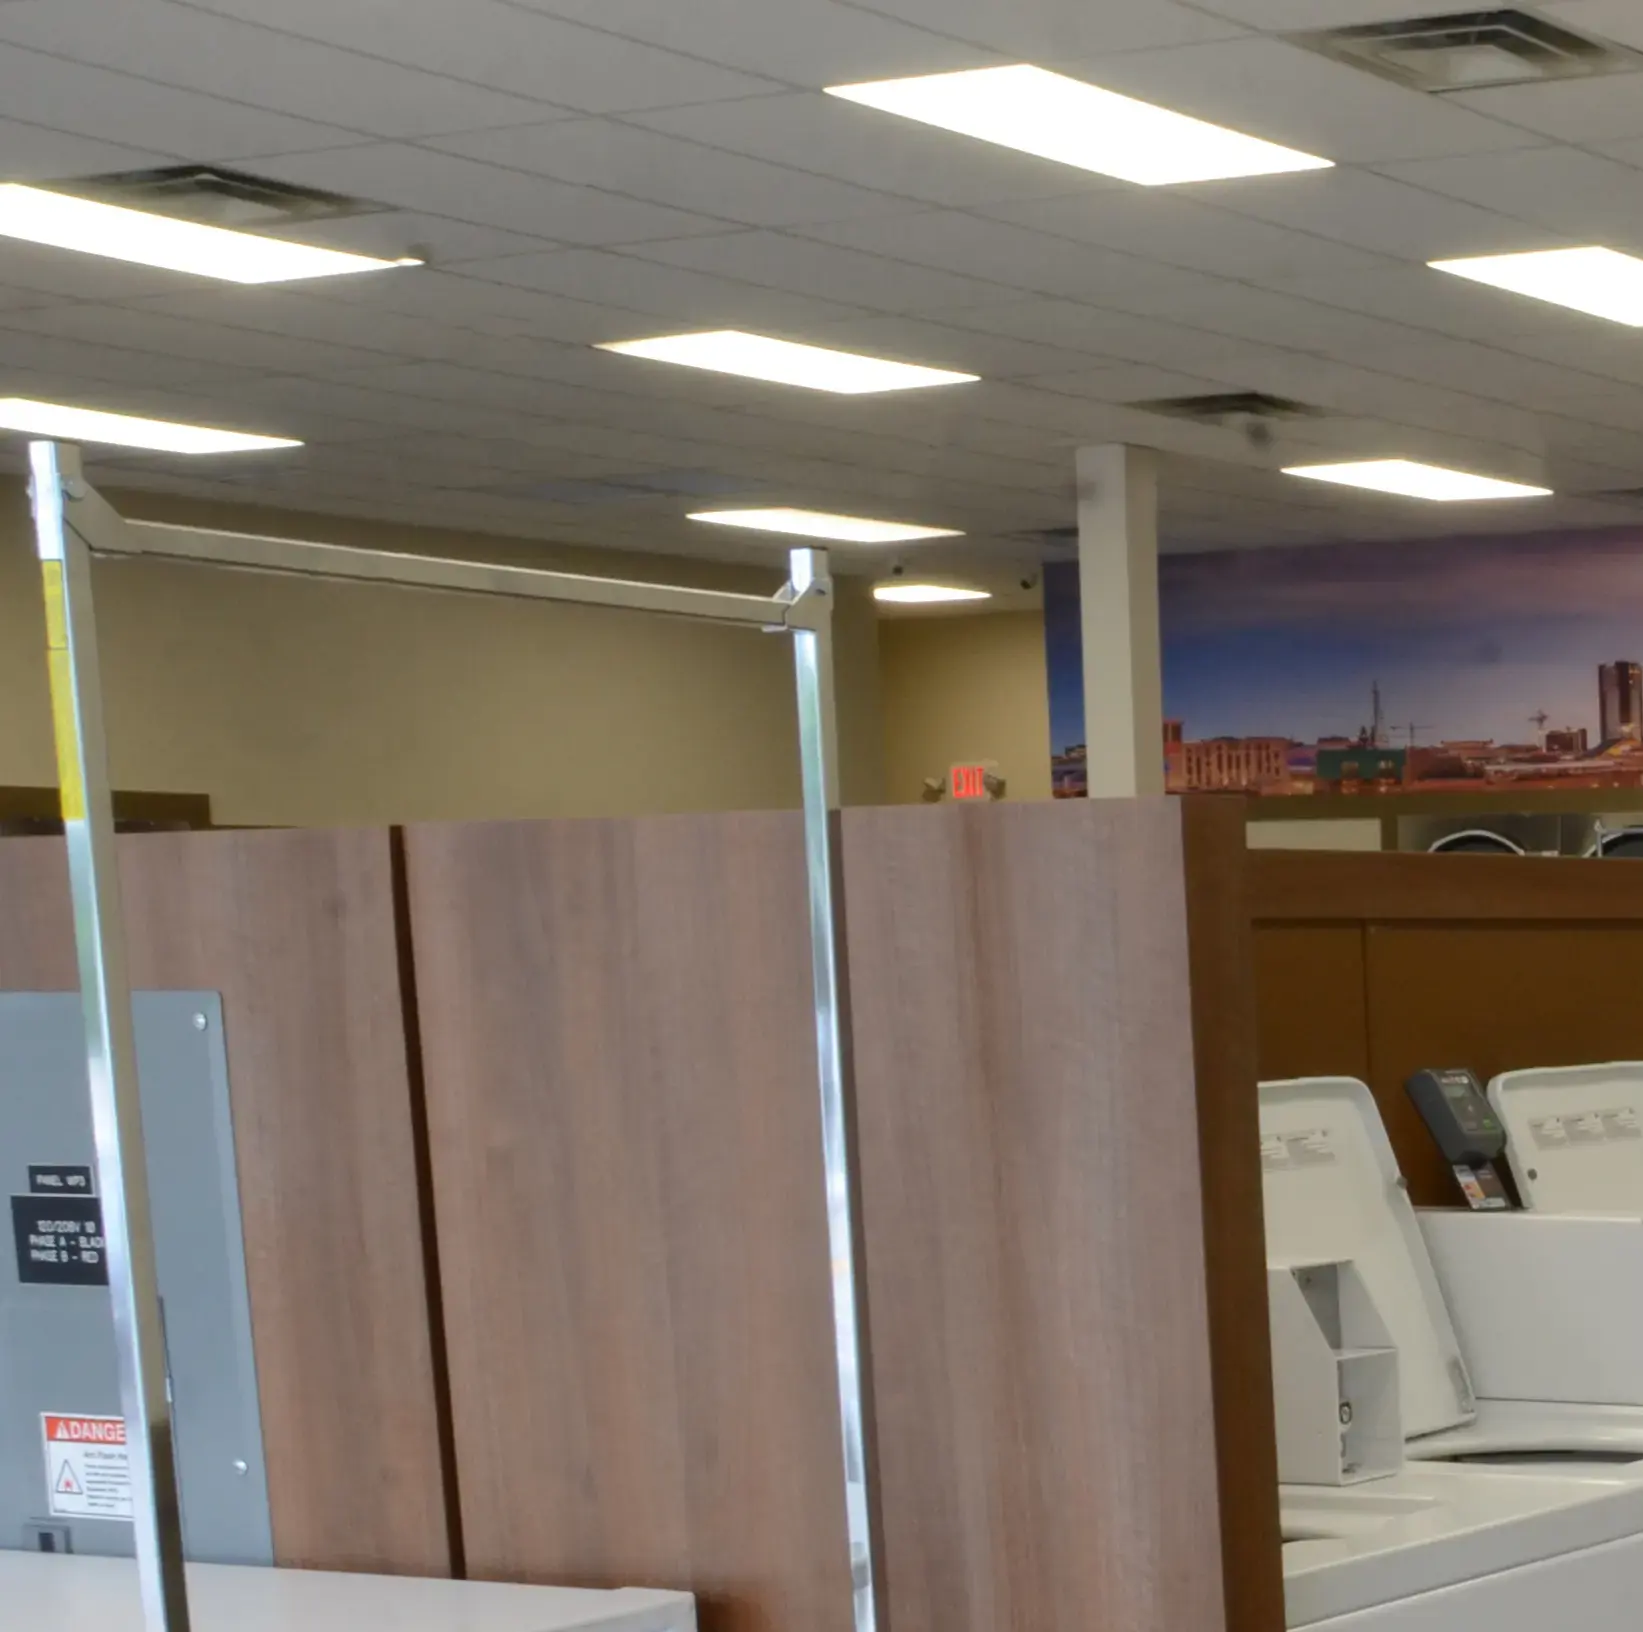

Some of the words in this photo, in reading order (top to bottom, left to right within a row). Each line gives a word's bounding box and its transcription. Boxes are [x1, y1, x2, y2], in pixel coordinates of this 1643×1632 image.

[953, 767, 984, 798] EXIT
[29, 1234, 56, 1248] PHASE
[30, 1249, 58, 1262] PHASE
[81, 1250, 99, 1264] RED
[69, 1420, 125, 1442] DANGE
